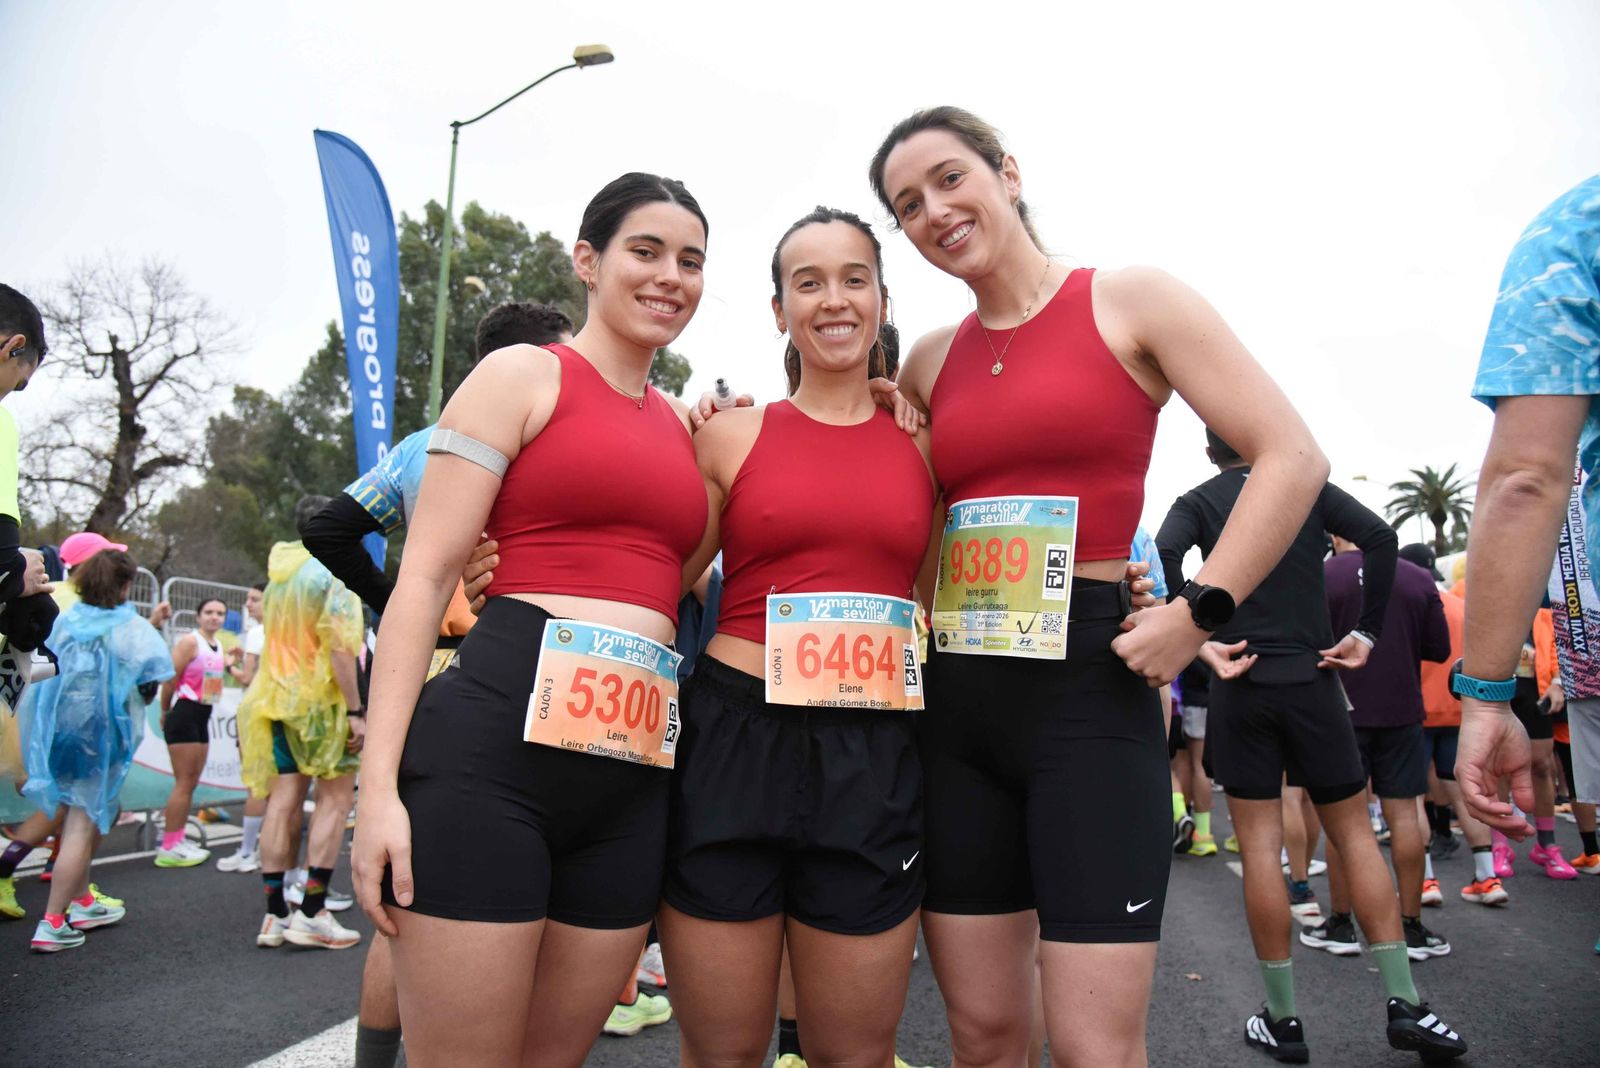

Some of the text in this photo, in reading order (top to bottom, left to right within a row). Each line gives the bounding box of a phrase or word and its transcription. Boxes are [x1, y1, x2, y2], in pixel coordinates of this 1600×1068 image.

[970, 501, 1019, 514] maratón
[980, 511, 1018, 524] sevilla
[1569, 500, 1584, 534] CIUDAD
[951, 537, 1030, 585] 9389
[1560, 545, 1575, 581] MEDIA
[1574, 535, 1591, 581] IBERCAJA
[827, 598, 883, 611] maratón
[843, 608, 884, 620] sevilla
[1565, 582, 1580, 618] RODI
[965, 637, 982, 646] HOKA
[1570, 619, 1586, 651] XXVII
[774, 656, 782, 685] CAJÓN
[796, 633, 897, 681] 6464
[539, 678, 553, 719] CAJÓN 3
[566, 667, 660, 734] 5300
[838, 683, 863, 693] Elene
[806, 698, 837, 707] Andrea
[870, 700, 892, 708] Bosch
[560, 738, 584, 750] Leire
[606, 729, 628, 742] Leire
